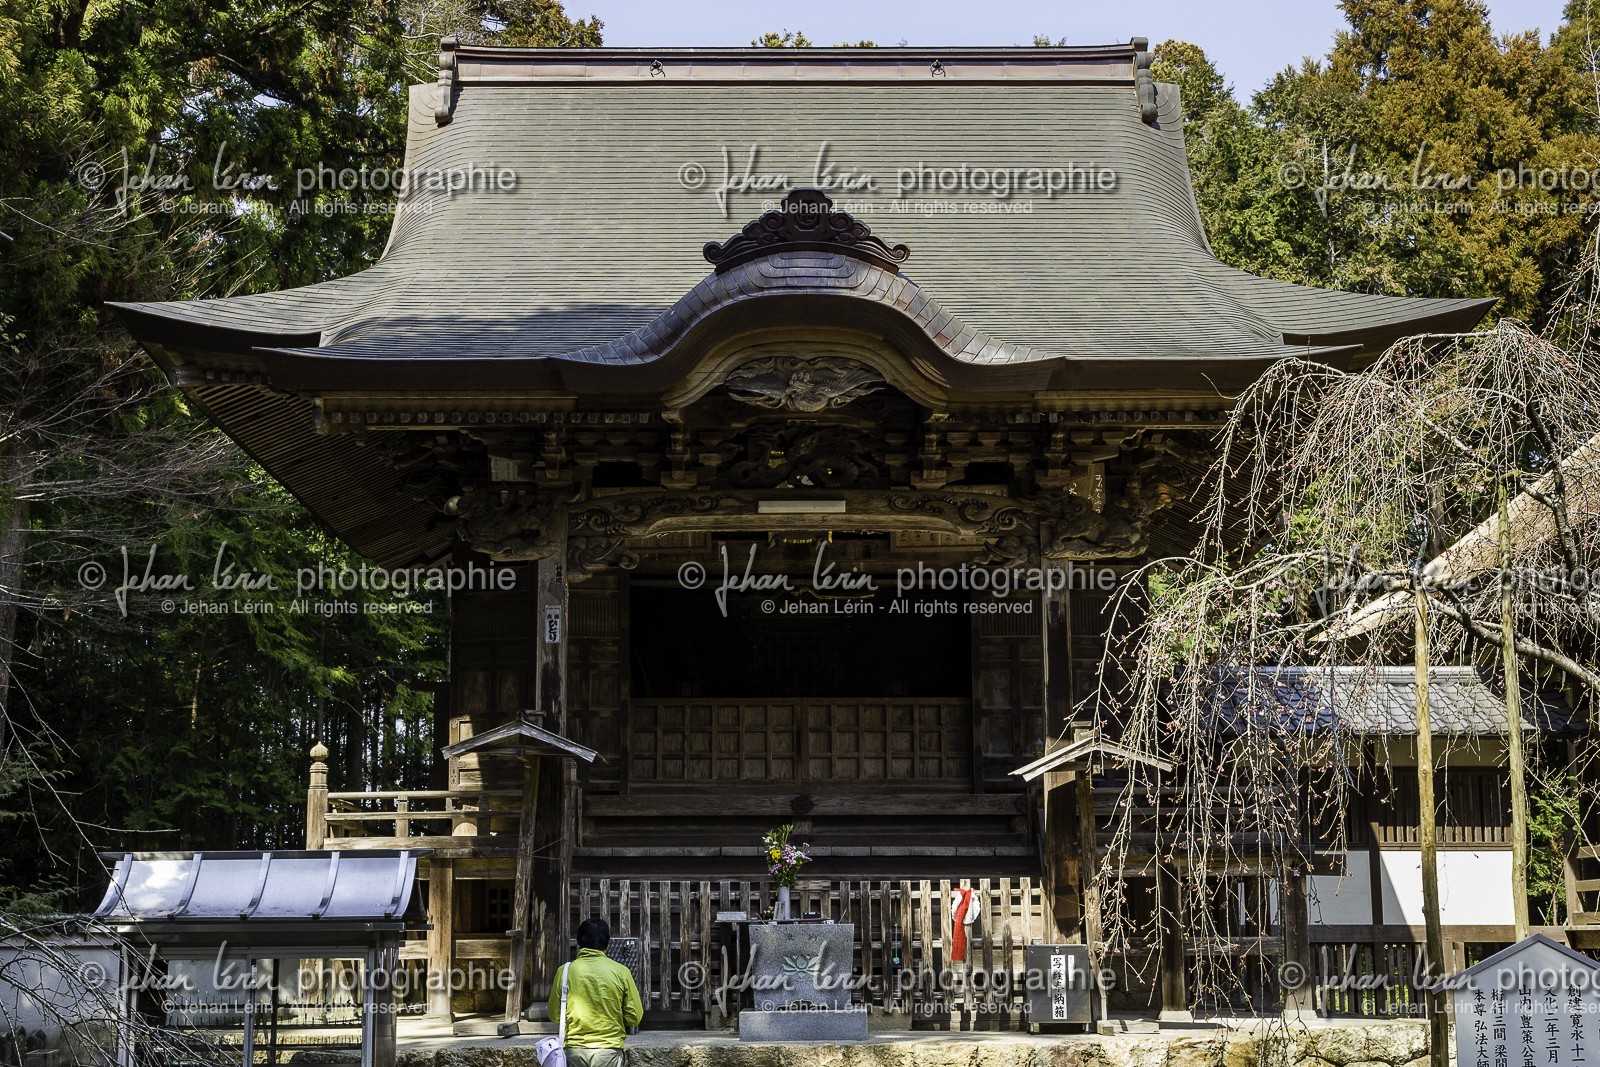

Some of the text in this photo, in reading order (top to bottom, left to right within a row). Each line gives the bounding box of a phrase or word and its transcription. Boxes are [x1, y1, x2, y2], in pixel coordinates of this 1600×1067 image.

[1568, 984, 1586, 1067] 創建寛永十一
